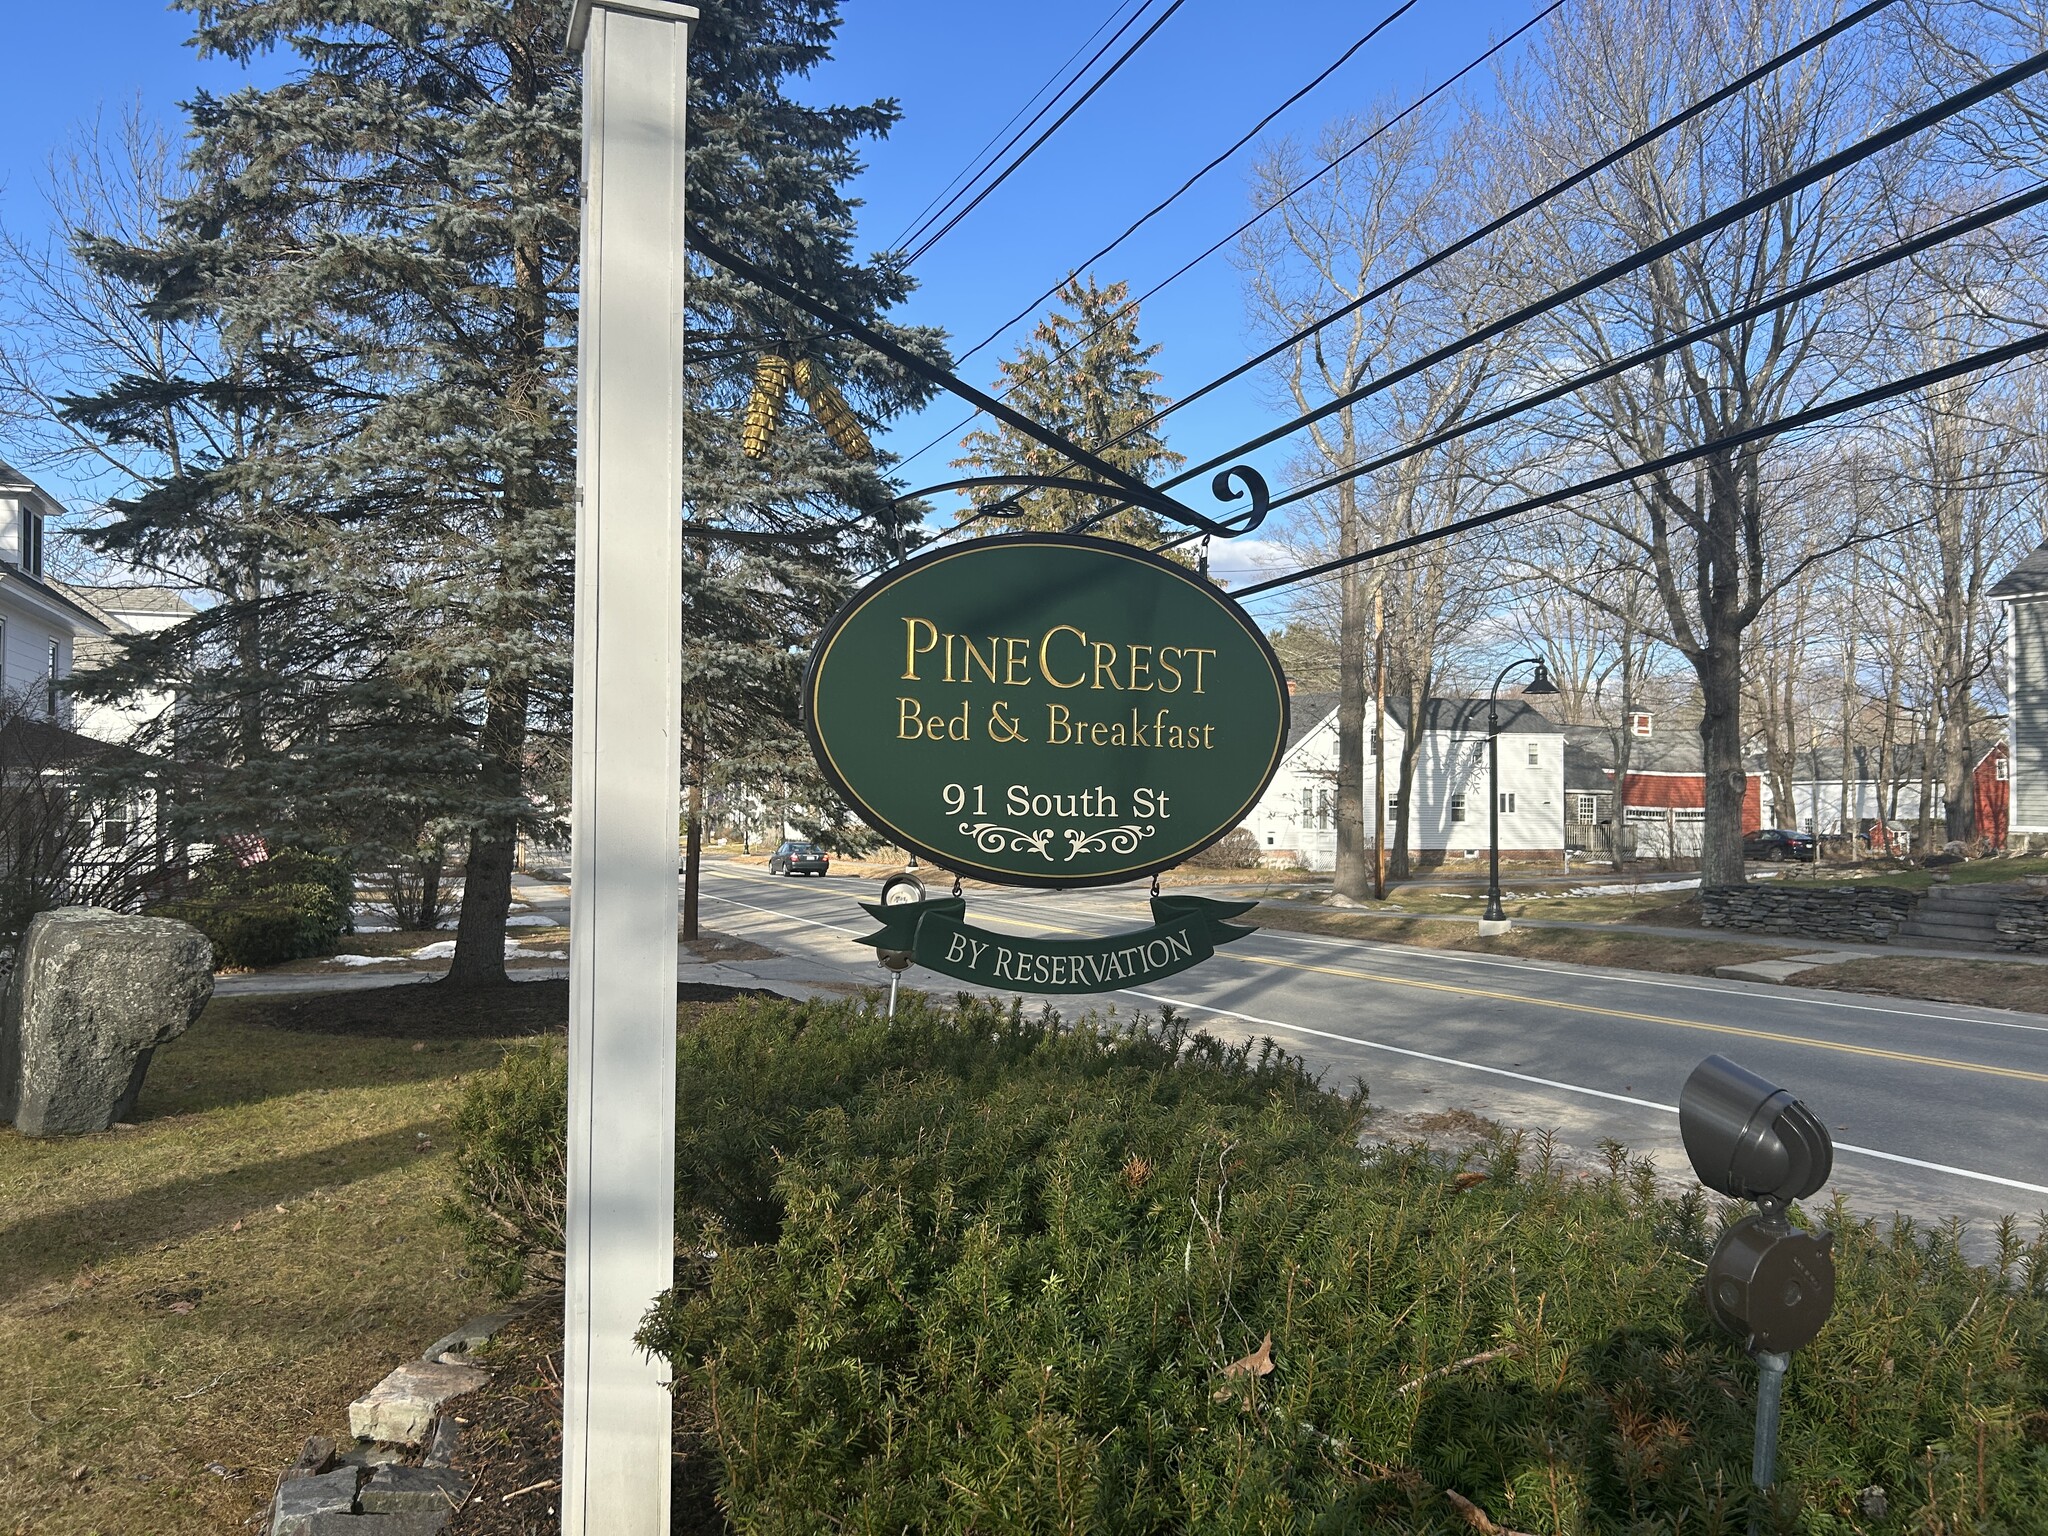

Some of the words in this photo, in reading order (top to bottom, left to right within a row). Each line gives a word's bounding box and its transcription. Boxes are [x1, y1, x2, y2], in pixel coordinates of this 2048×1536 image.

[896, 697, 970, 741] Bed
[988, 701, 1028, 743] &
[1046, 703, 1214, 750] Breakfast
[943, 783, 987, 815] 91
[1007, 785, 1117, 818] South
[1133, 787, 1170, 819] St
[945, 932, 989, 969] BY
[994, 929, 1192, 986] RESERVATION
